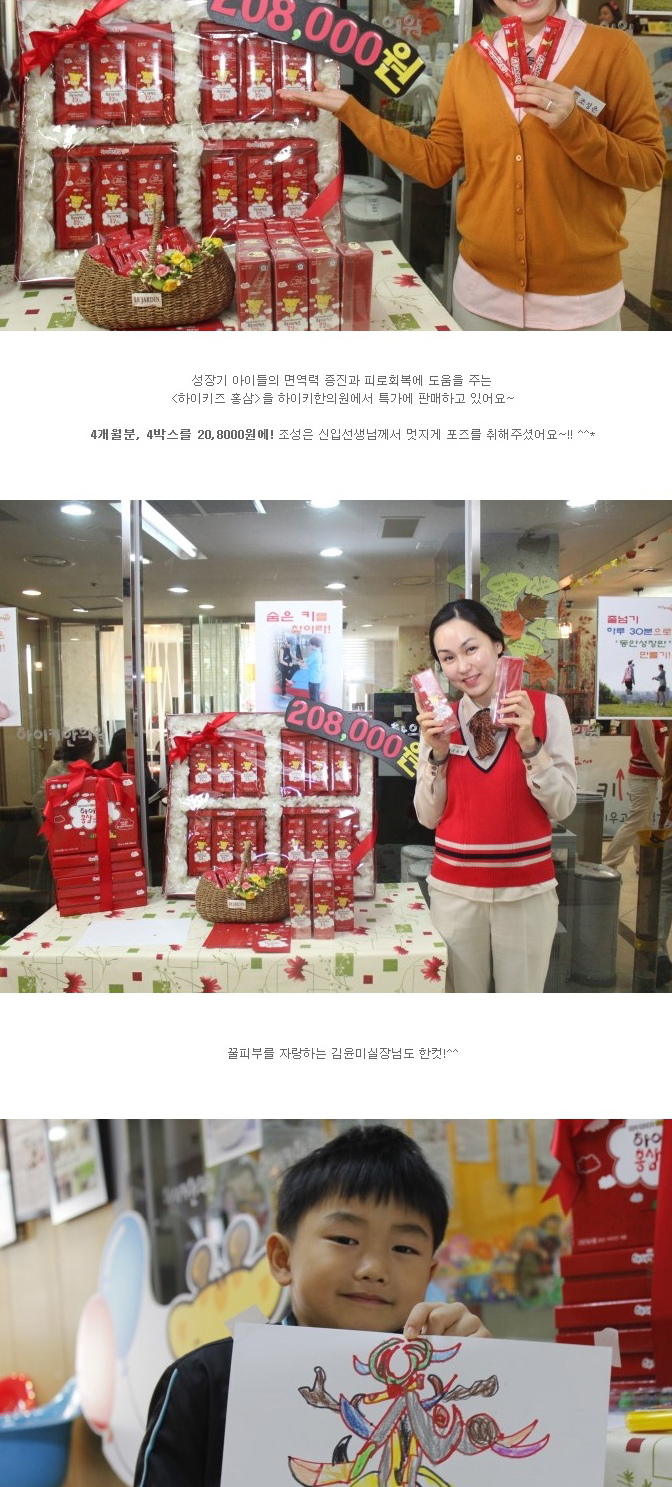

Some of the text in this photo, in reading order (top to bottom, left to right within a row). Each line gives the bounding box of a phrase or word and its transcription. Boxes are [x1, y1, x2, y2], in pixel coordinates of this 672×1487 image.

[141, 296, 160, 304] JARDIN
[266, 610, 327, 623] 숨은 키를
[607, 615, 639, 625] 줄넘기
[291, 624, 331, 635] 찾아라!
[606, 627, 672, 636] 하루 30분으로
[639, 651, 671, 660] 만들기!
